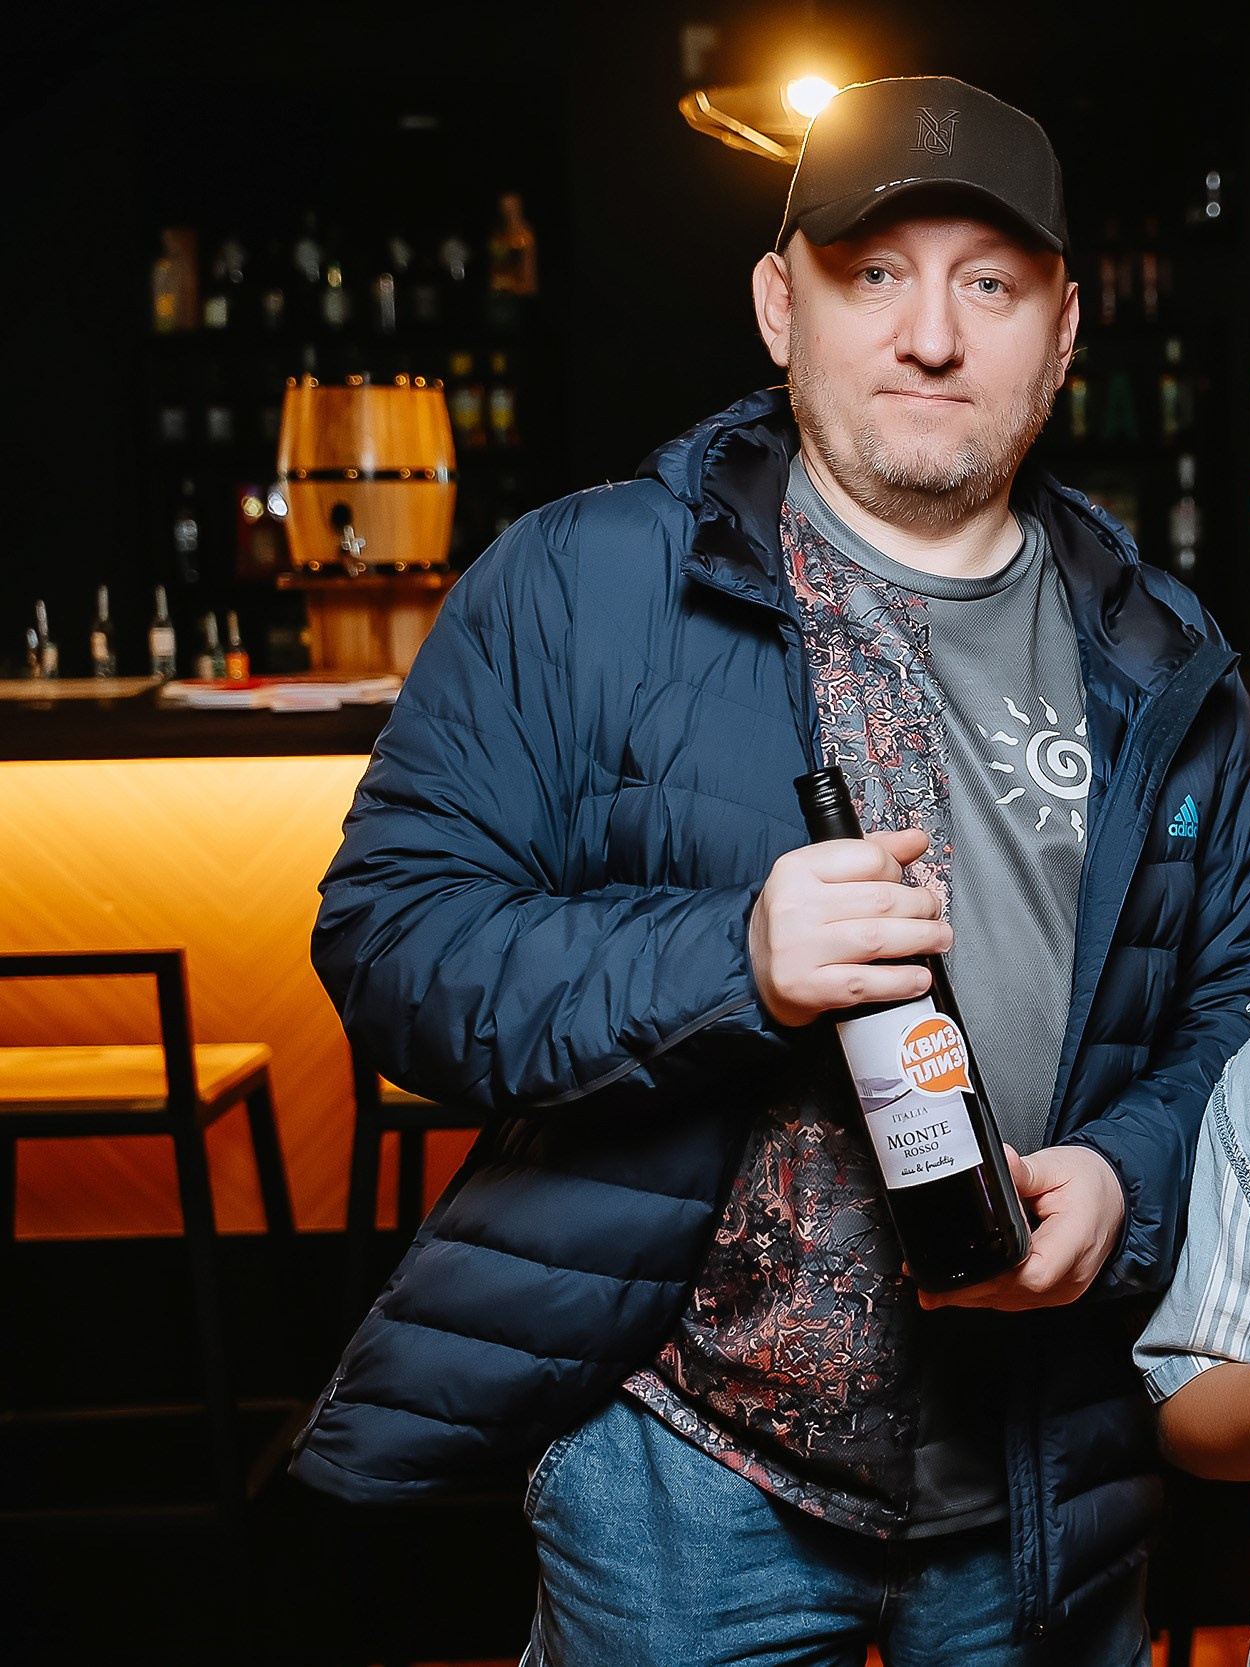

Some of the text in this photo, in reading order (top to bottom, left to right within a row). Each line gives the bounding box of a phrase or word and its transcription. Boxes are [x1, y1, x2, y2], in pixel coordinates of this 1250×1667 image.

[902, 1025, 962, 1065] КВИЗ,
[906, 1044, 966, 1084] ПЛИЗ!
[892, 1106, 929, 1124] ITALIA
[886, 1120, 952, 1150] MONTE
[903, 1141, 940, 1159] ROSSO
[916, 1163, 924, 1173] &
